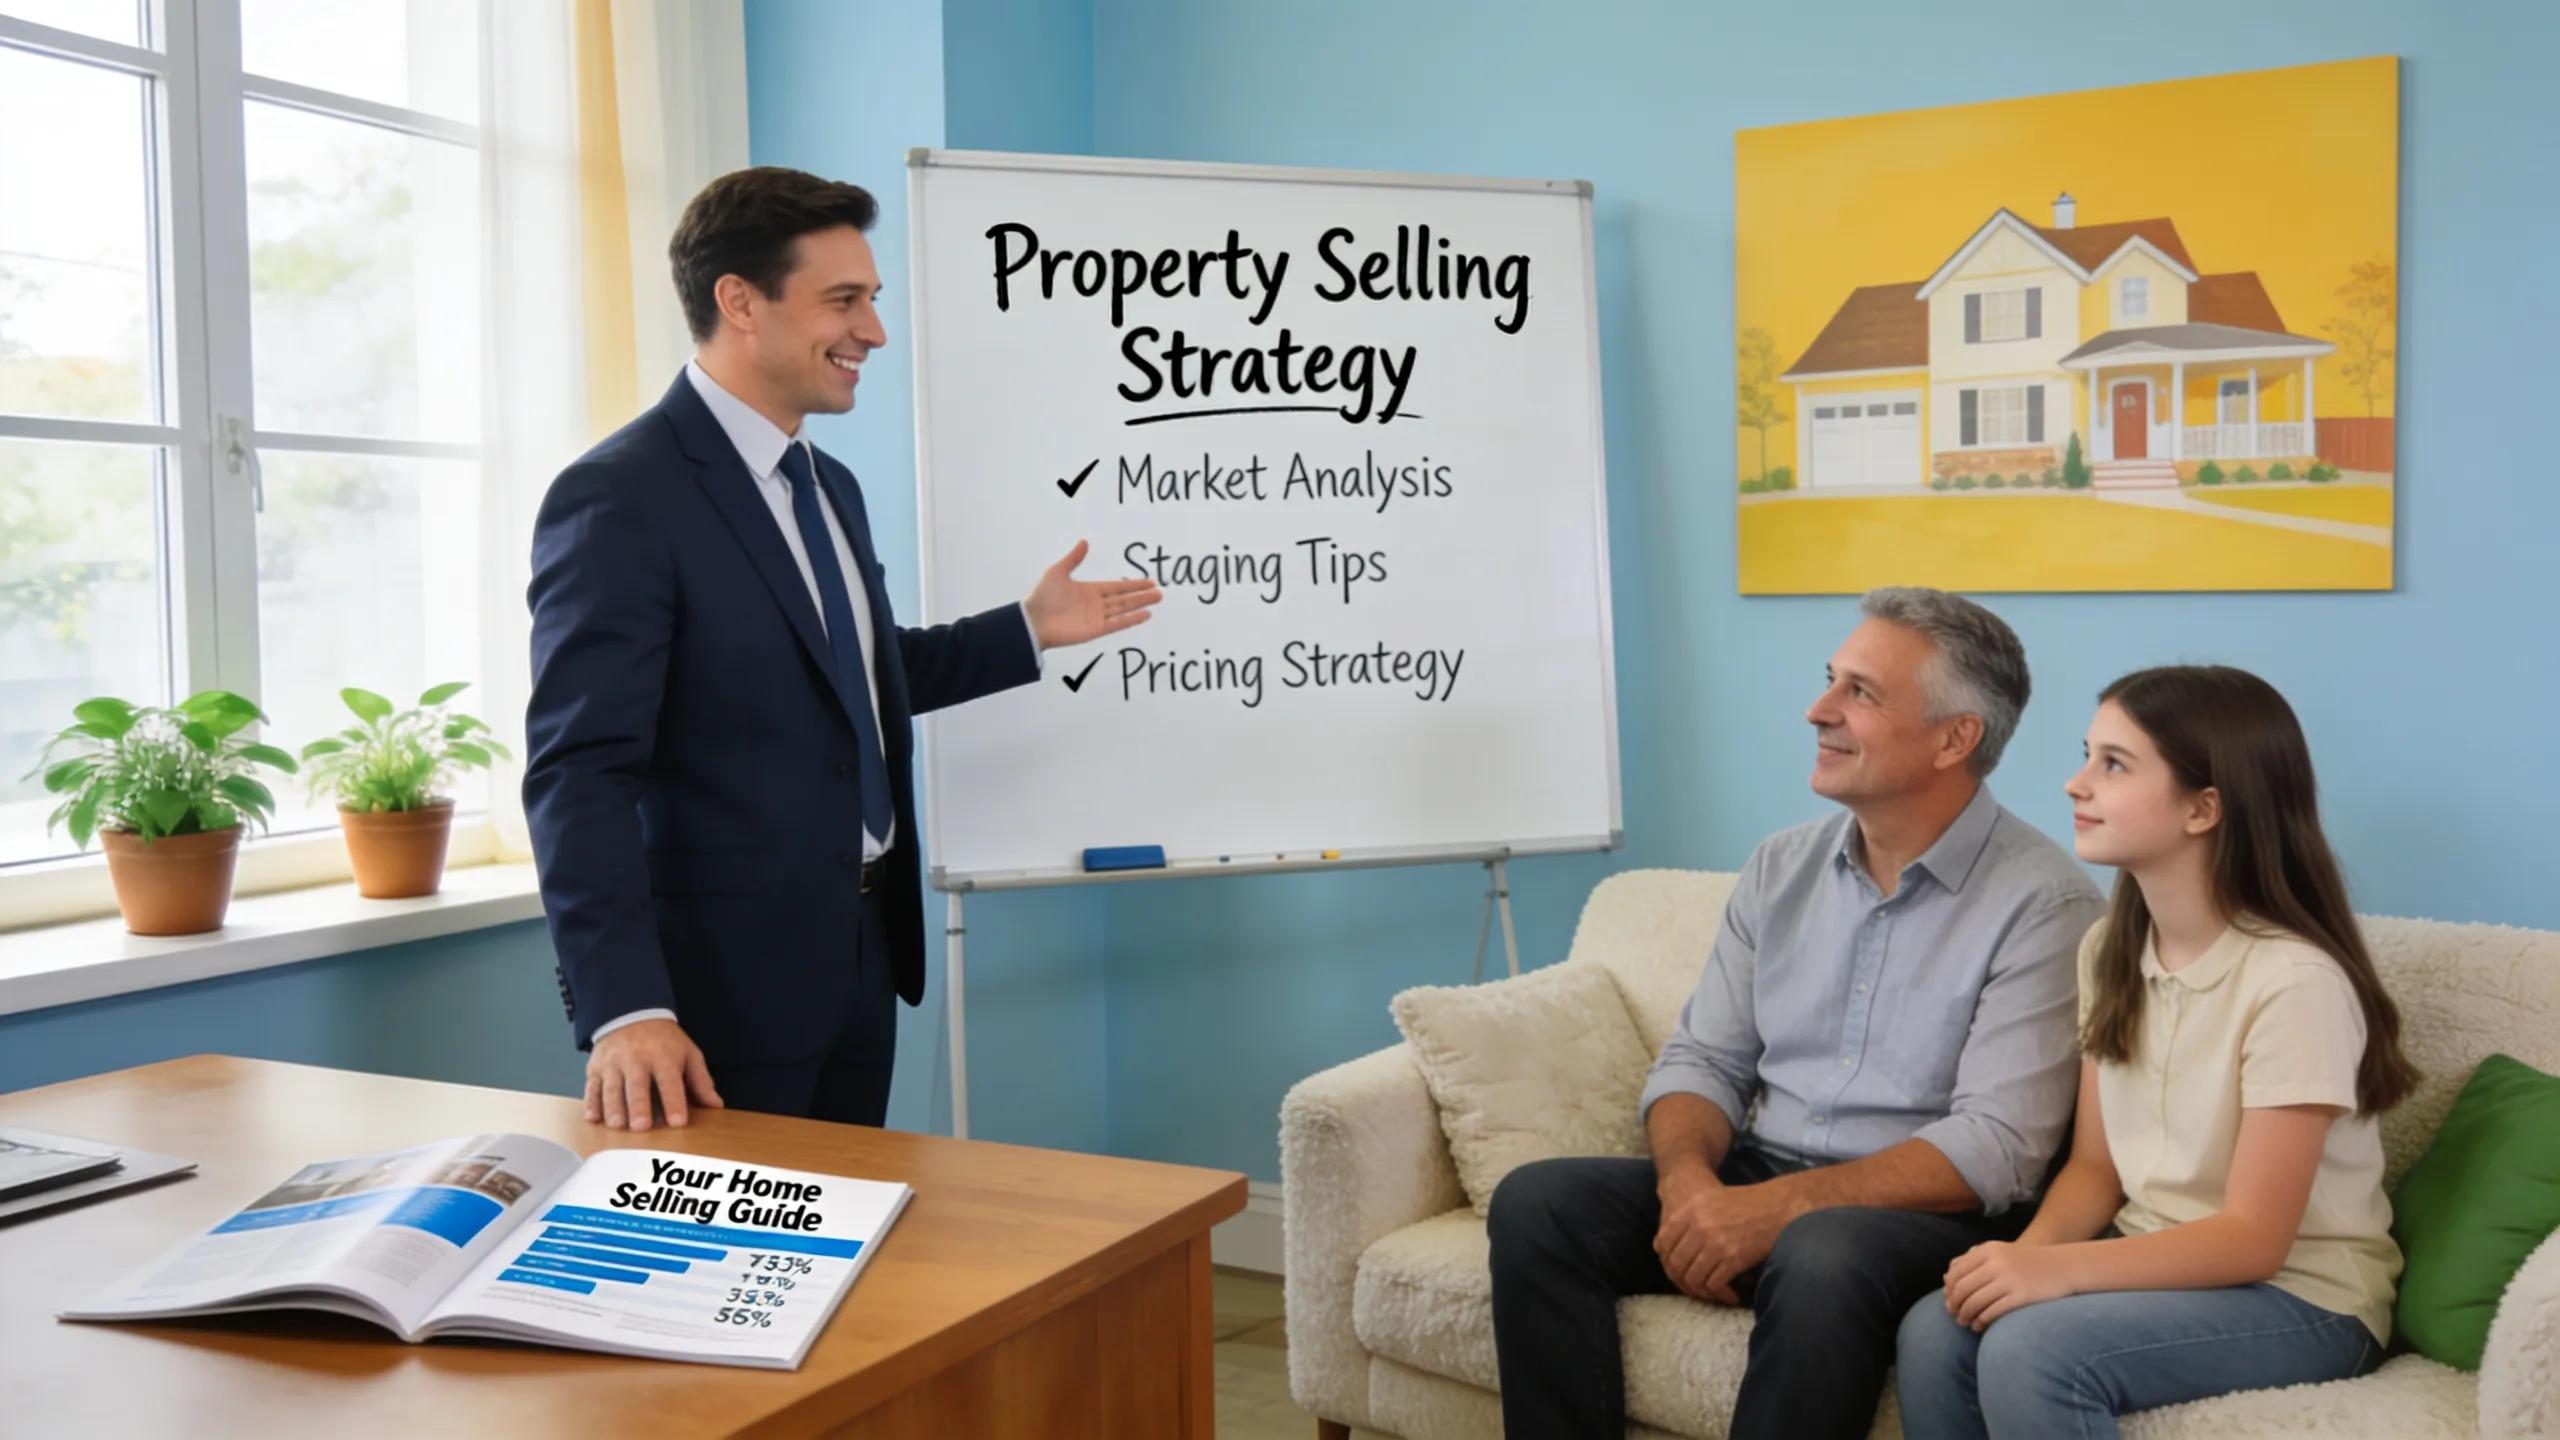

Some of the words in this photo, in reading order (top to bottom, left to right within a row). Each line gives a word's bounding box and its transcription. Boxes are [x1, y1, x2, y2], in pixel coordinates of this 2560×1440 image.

[985, 222, 1290, 328] Property
[1314, 223, 1532, 335] Selling
[1117, 326, 1417, 425] Strategy
[1118, 451, 1269, 505] Market
[1283, 449, 1454, 514] Analysis
[1122, 541, 1283, 605] Staging
[1295, 536, 1389, 605] Tips
[1119, 644, 1264, 708] Pricing
[1281, 640, 1466, 703] Strategy
[609, 1181, 720, 1225] Selling
[727, 1197, 824, 1233] Guide
[651, 1157, 724, 1191] Your
[726, 1168, 824, 1204] Home
